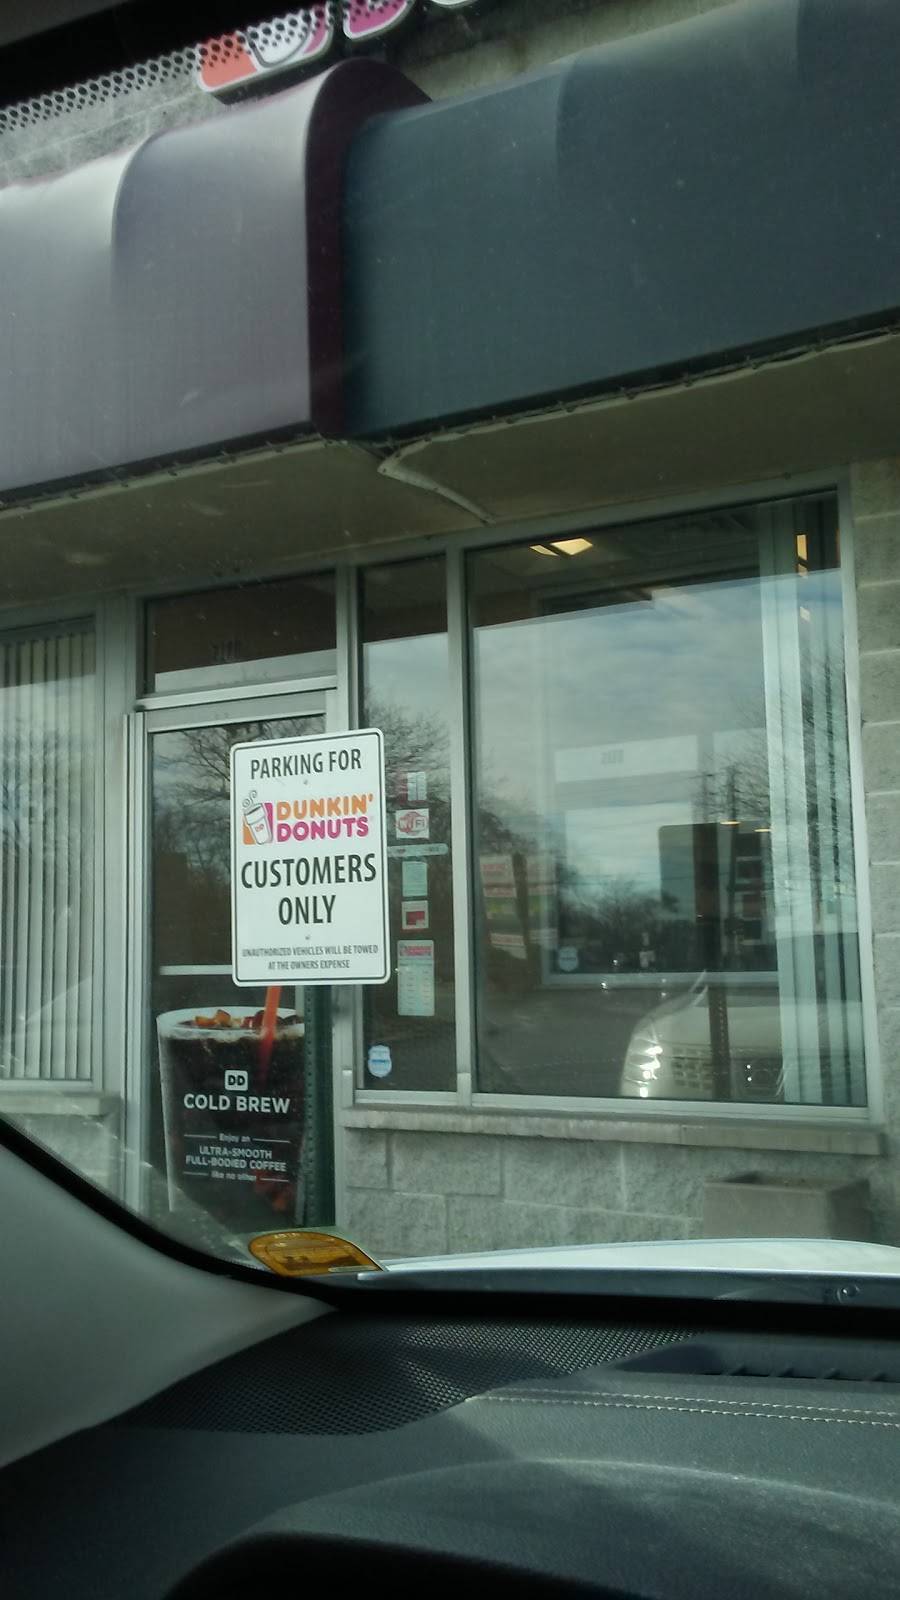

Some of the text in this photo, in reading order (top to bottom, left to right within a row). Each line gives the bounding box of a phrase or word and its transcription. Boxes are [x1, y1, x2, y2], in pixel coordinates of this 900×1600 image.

[251, 748, 362, 780] PARKING FOR
[276, 793, 374, 820] DUNKIN'
[276, 815, 369, 842] DONUTS
[241, 853, 377, 889] CUSTOMERS
[278, 894, 336, 926] ONLY
[242, 944, 378, 957] UNAUTHORIZED VEHICLES WILL BE TOWED
[268, 959, 350, 970] AT THE OWNERS EXPENSE
[228, 1075, 245, 1086] DD
[183, 1093, 291, 1114] COLD BREW
[219, 1133, 239, 1143] Enjoy
[199, 1146, 273, 1159] ULTRA-SMOOTH
[185, 1155, 287, 1172] FULL-BODIED COFFEE
